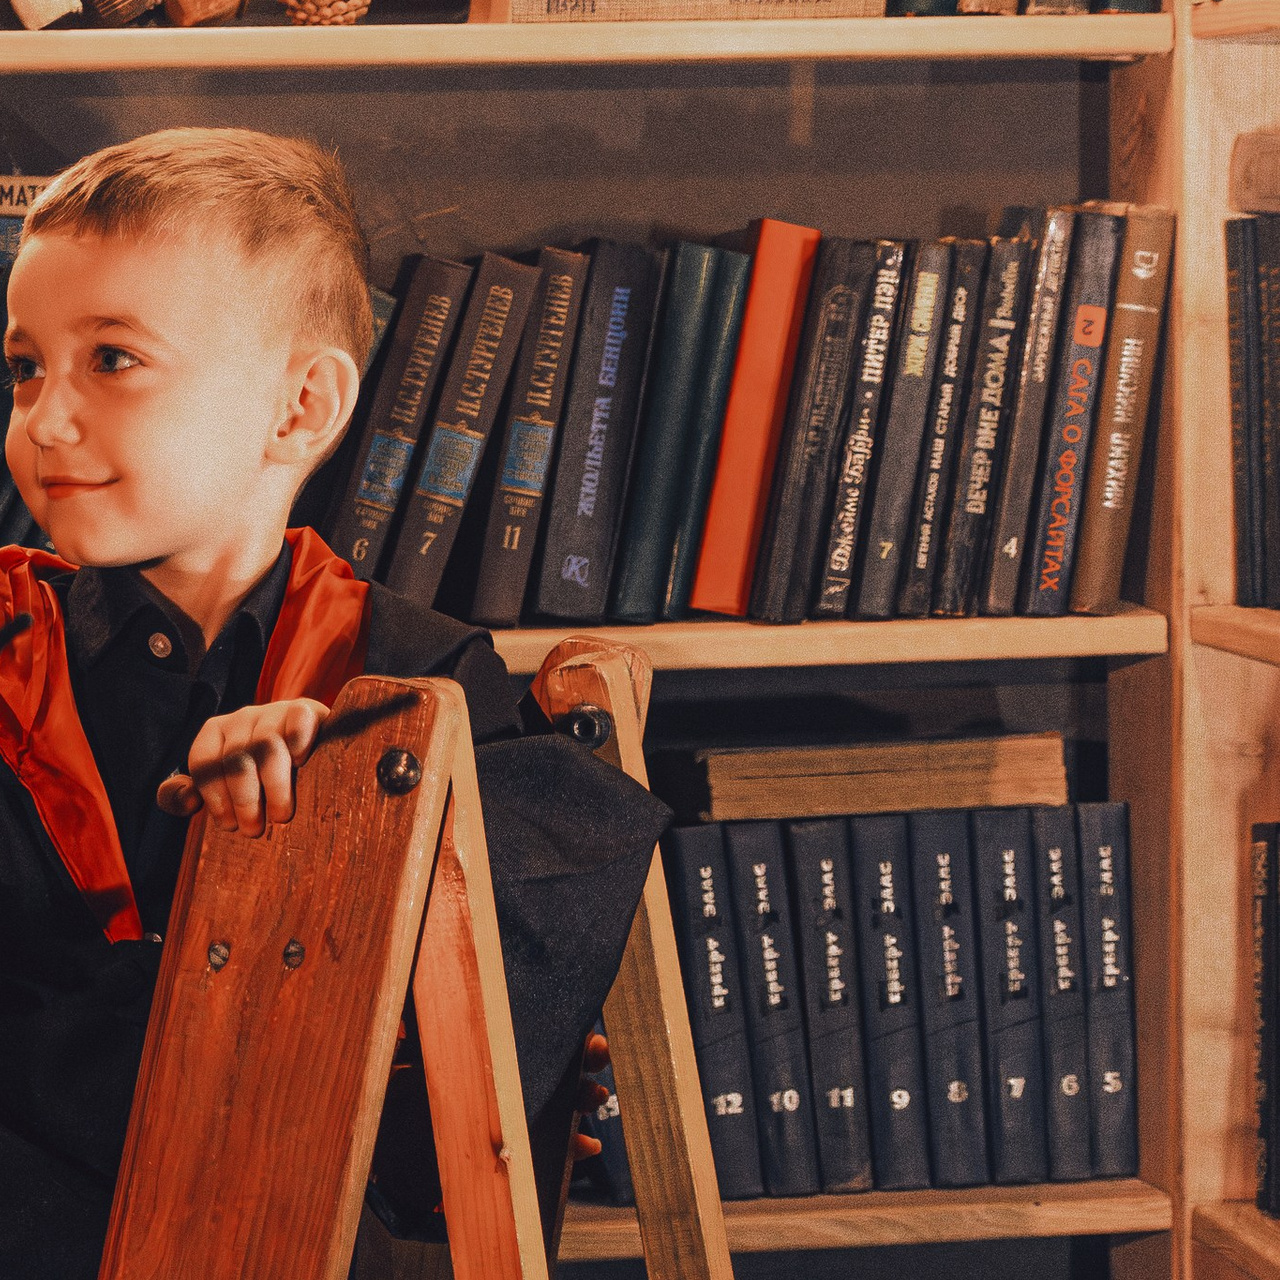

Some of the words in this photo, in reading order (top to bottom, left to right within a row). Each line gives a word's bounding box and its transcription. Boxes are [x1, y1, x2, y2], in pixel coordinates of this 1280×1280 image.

[874, 268, 901, 310] ПЭН
[952, 287, 968, 322] ДВОР
[1080, 317, 1096, 337] 2
[862, 313, 890, 383] ПИТЕР
[943, 324, 962, 377] ДОБРЫЙ
[982, 332, 1012, 407] ДОМА
[1114, 338, 1145, 424] НИКУЛИН
[577, 397, 612, 517] ЖЮЛЬЕТТА
[597, 286, 632, 387] БЕНЦОНИ
[1065, 358, 1093, 418] САГА
[936, 382, 953, 435] СТАРЫЙ
[975, 408, 1000, 450] ВНЕ
[1061, 422, 1083, 443] О
[929, 438, 945, 469] НАШ
[965, 451, 993, 515] ВЕЧЕР
[1101, 432, 1131, 510] МИХАИЛ
[831, 488, 860, 572] Джеймс
[1039, 449, 1077, 592] ФОРСАЙТАХ
[352, 538, 369, 562] 6
[419, 532, 435, 556] 7
[502, 526, 521, 550] 11
[879, 542, 893, 559] 7
[1002, 536, 1019, 558] 4
[948, 1079, 969, 1104] 8
[1007, 1075, 1026, 1098] 7
[1061, 1075, 1080, 1097] 6
[1103, 1071, 1122, 1093] 5
[712, 1091, 745, 1116] 12
[770, 1089, 800, 1112] 10
[826, 1086, 855, 1109] 11
[890, 1088, 912, 1111] 9
